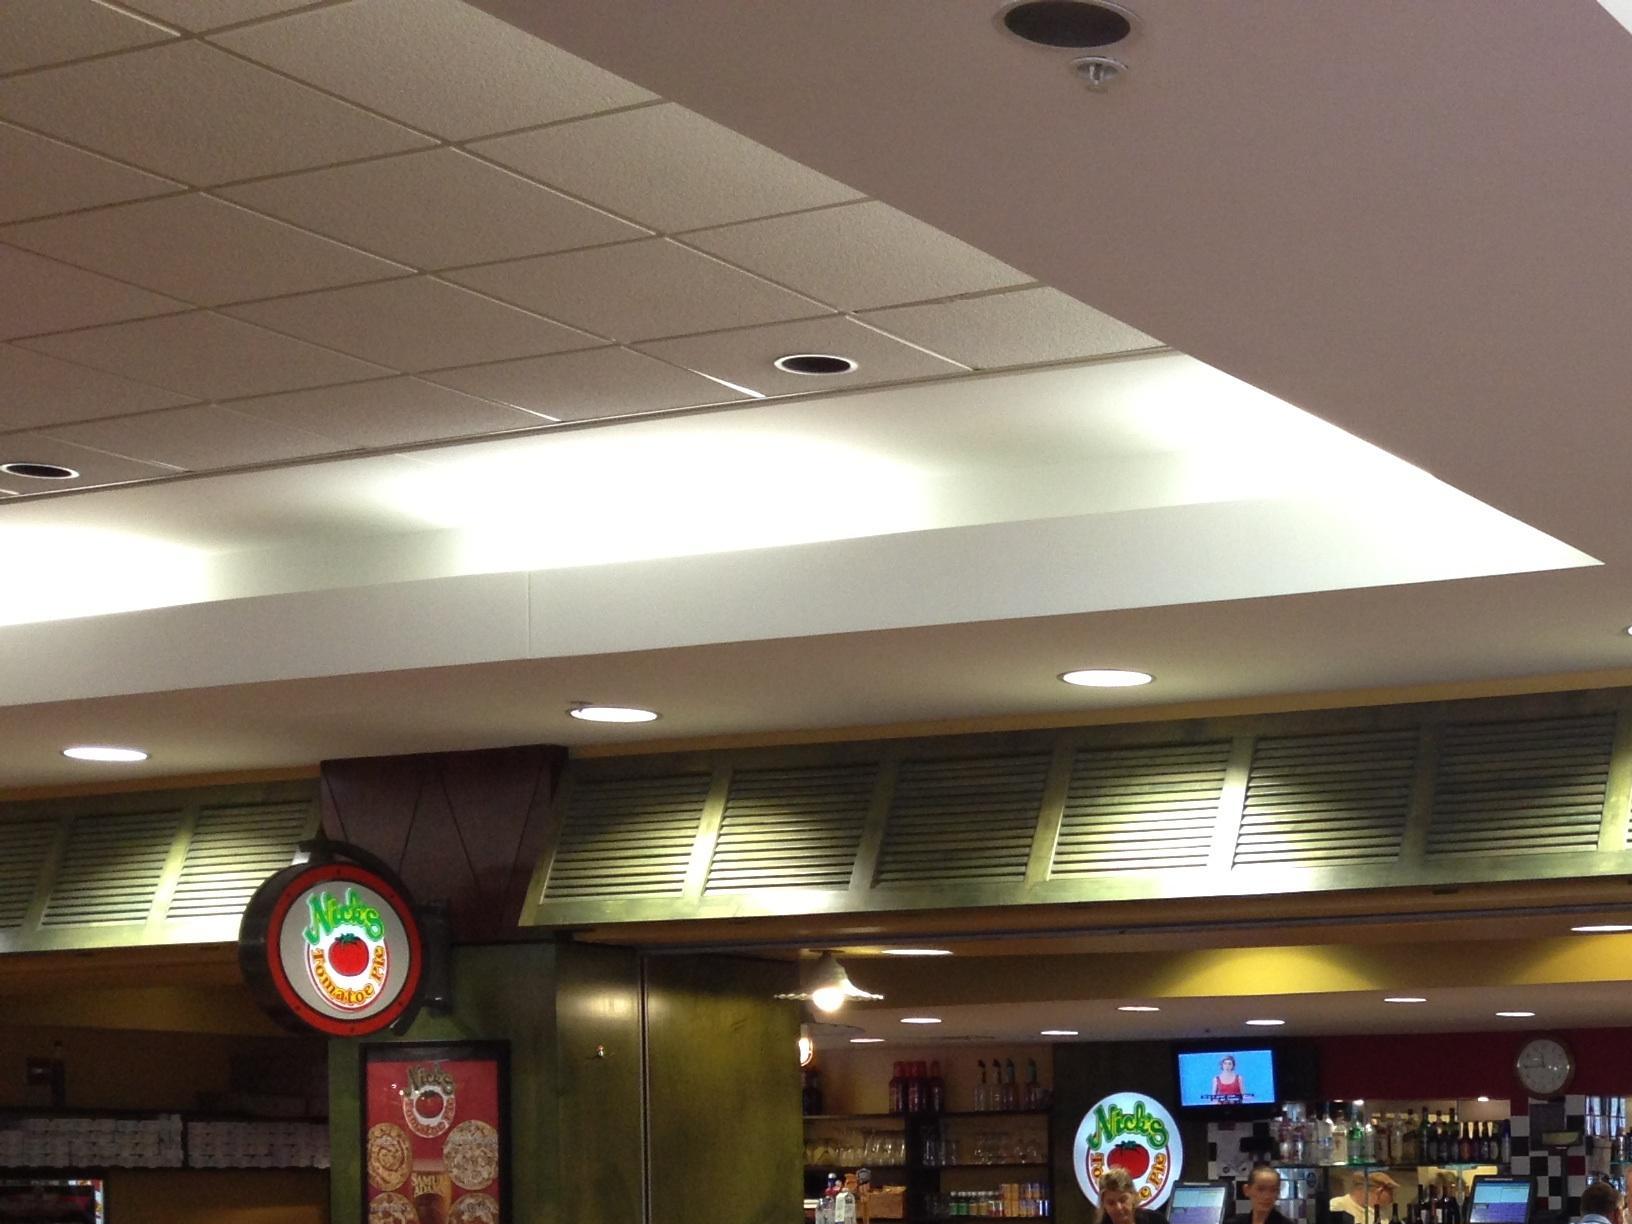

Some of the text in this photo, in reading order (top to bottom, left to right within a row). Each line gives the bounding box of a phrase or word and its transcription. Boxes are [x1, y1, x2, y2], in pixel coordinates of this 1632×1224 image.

[311, 945, 385, 1004] Tomatoe Pie
[1087, 1101, 1169, 1150] Nick's
[1147, 1153, 1166, 1190] Pie
